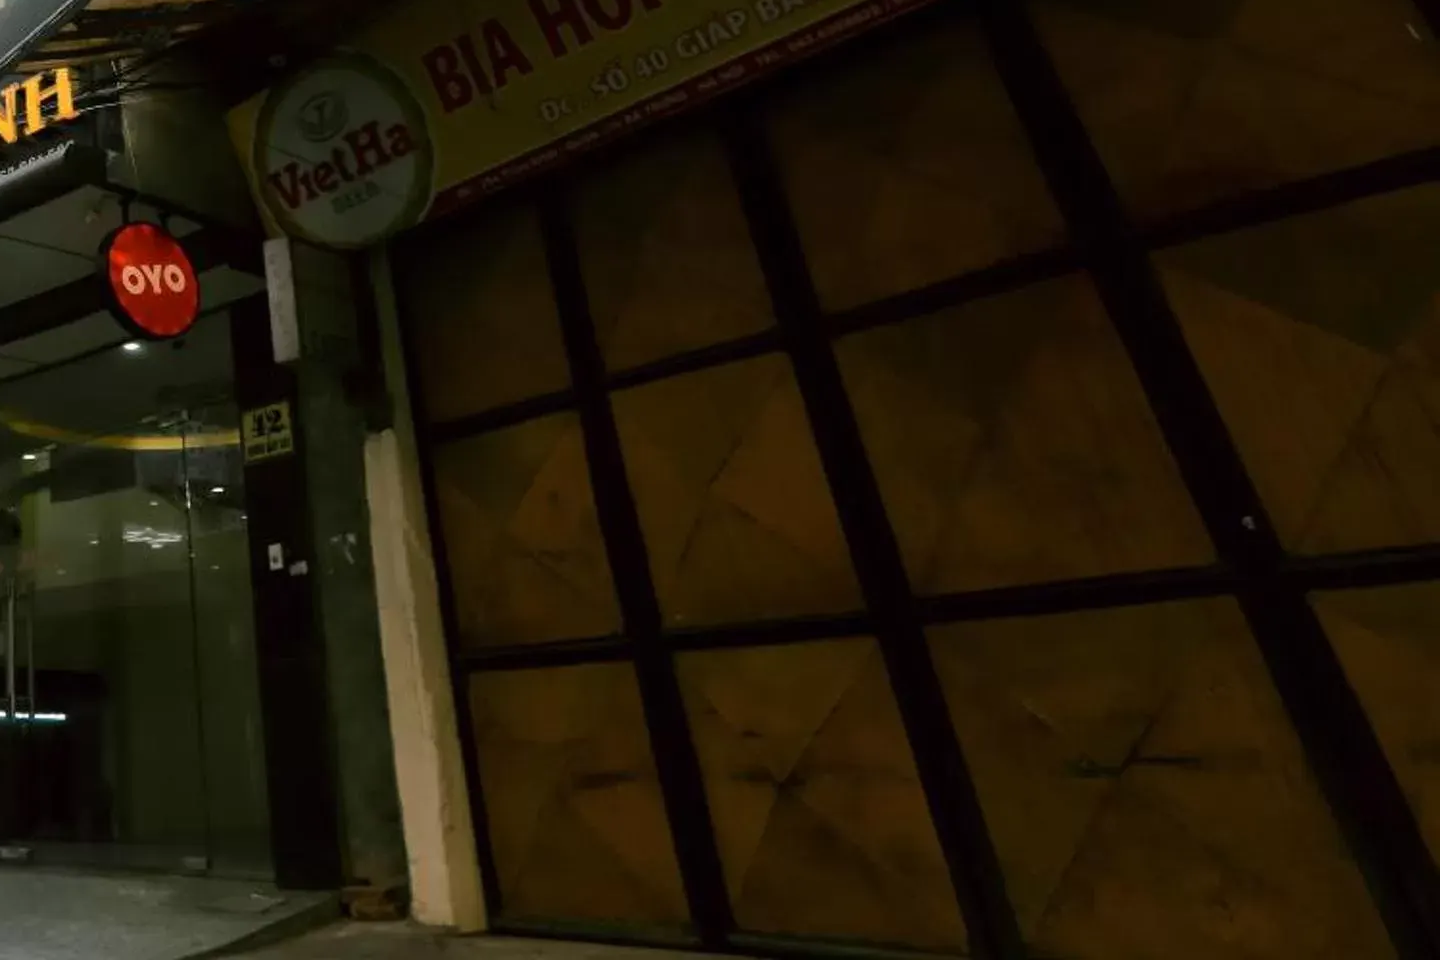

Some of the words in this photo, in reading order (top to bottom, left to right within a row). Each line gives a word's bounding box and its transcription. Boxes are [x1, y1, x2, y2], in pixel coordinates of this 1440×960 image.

[421, 18, 534, 115] BIA
[633, 46, 670, 83] 40
[122, 263, 187, 296] OYO
[251, 408, 285, 438] 42
